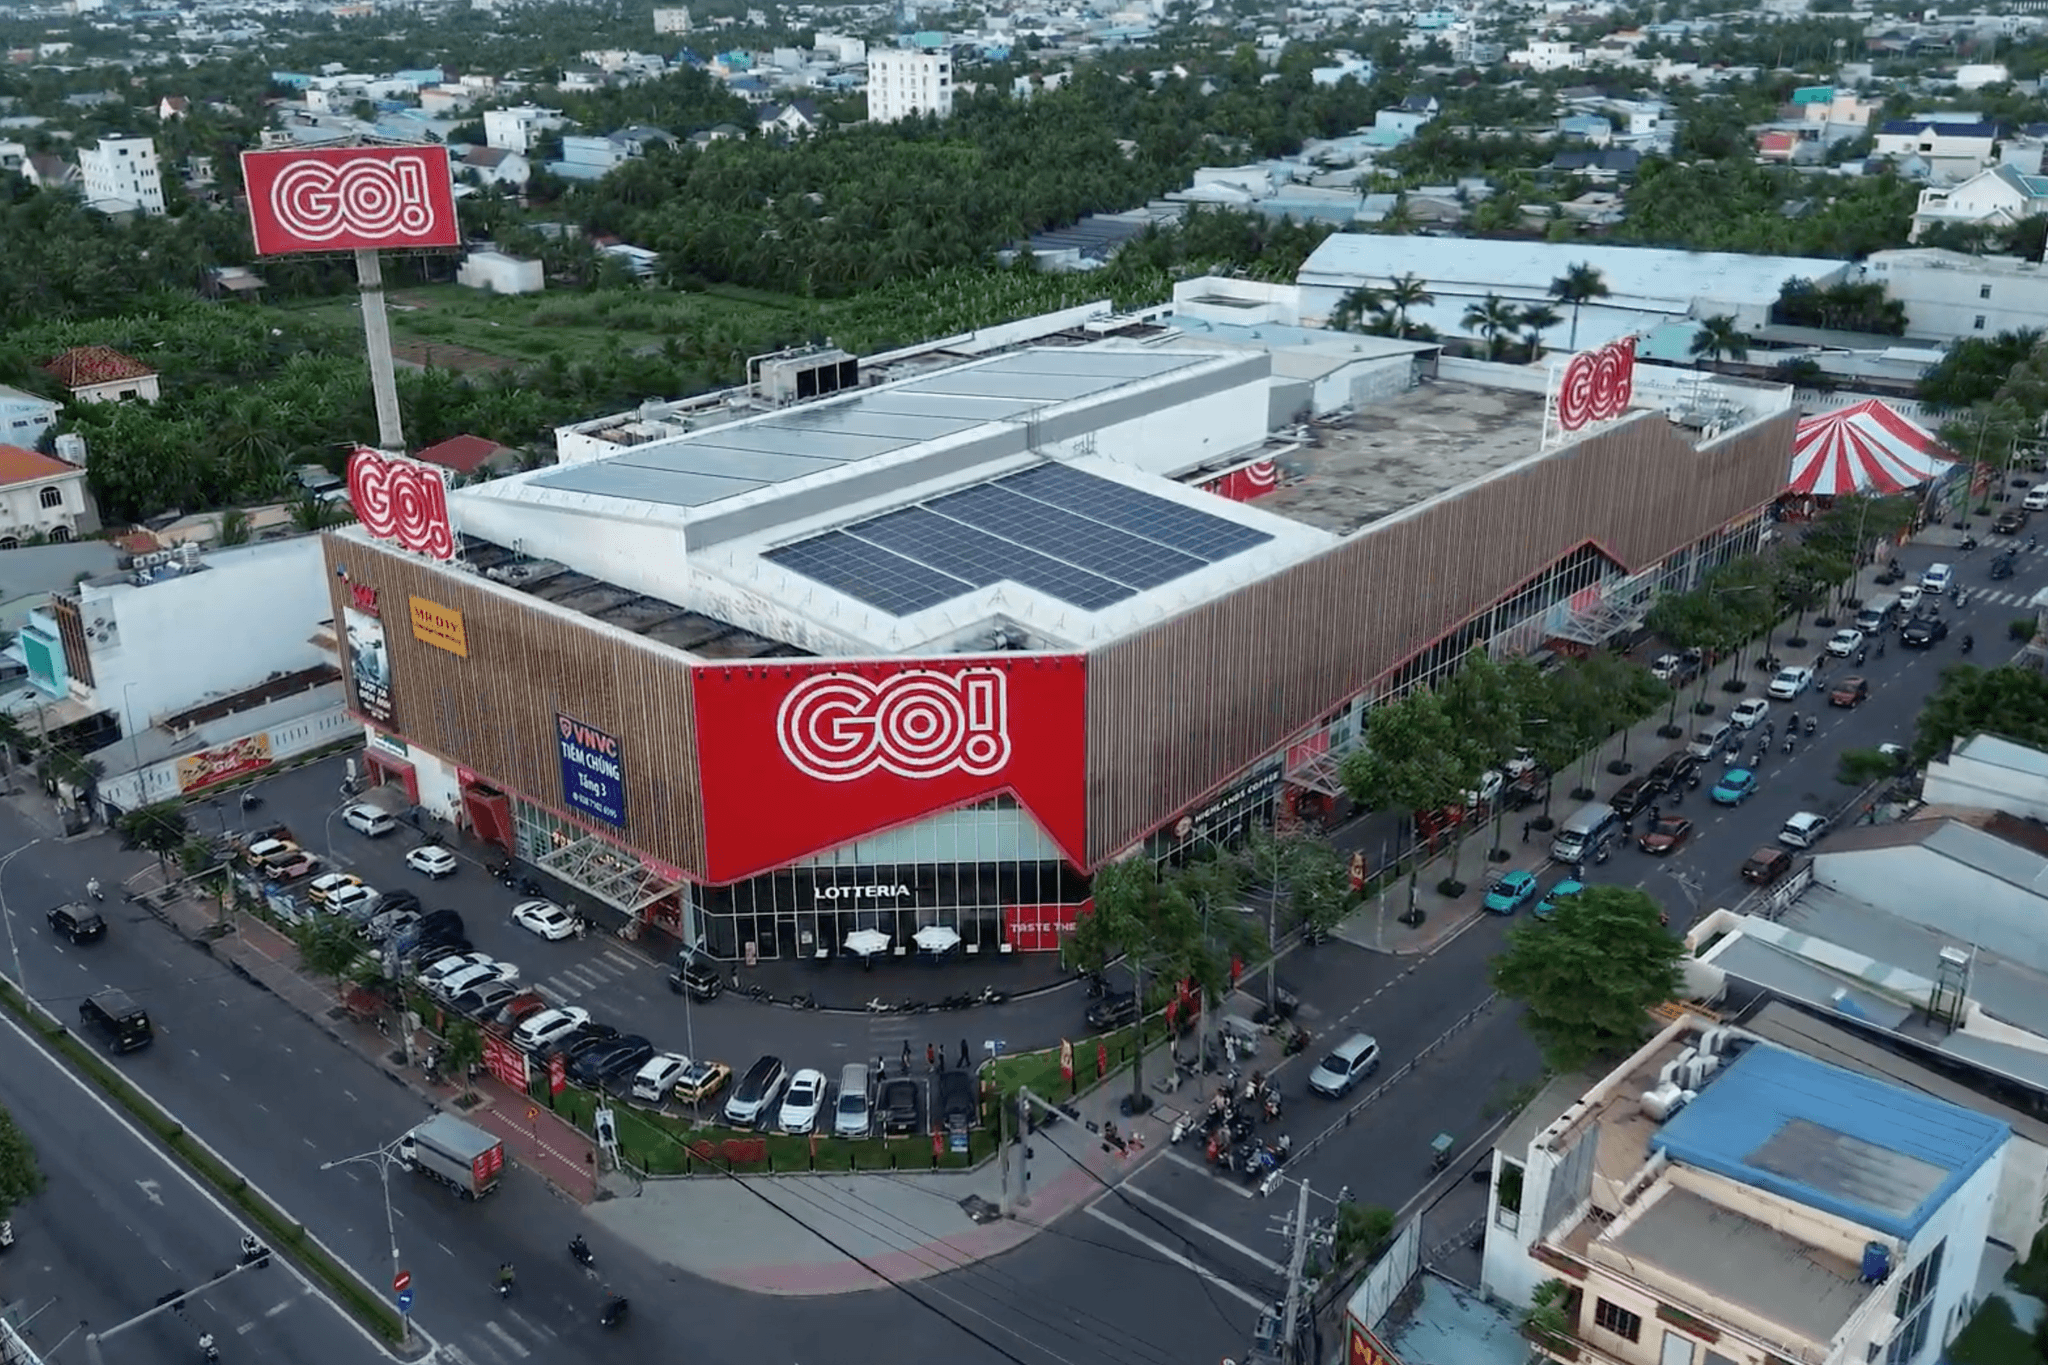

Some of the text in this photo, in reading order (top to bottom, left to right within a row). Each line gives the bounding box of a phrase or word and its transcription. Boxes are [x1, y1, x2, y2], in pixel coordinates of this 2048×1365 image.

[271, 156, 434, 241] GO!
[1558, 336, 1635, 431] GO!
[347, 448, 455, 560] GO!
[573, 722, 617, 758] VNVC
[777, 667, 1011, 782] GO!
[600, 782, 607, 797] 3
[1195, 771, 1279, 822] HIGHLANDS COFFEE
[815, 885, 910, 899] LOTTERIA
